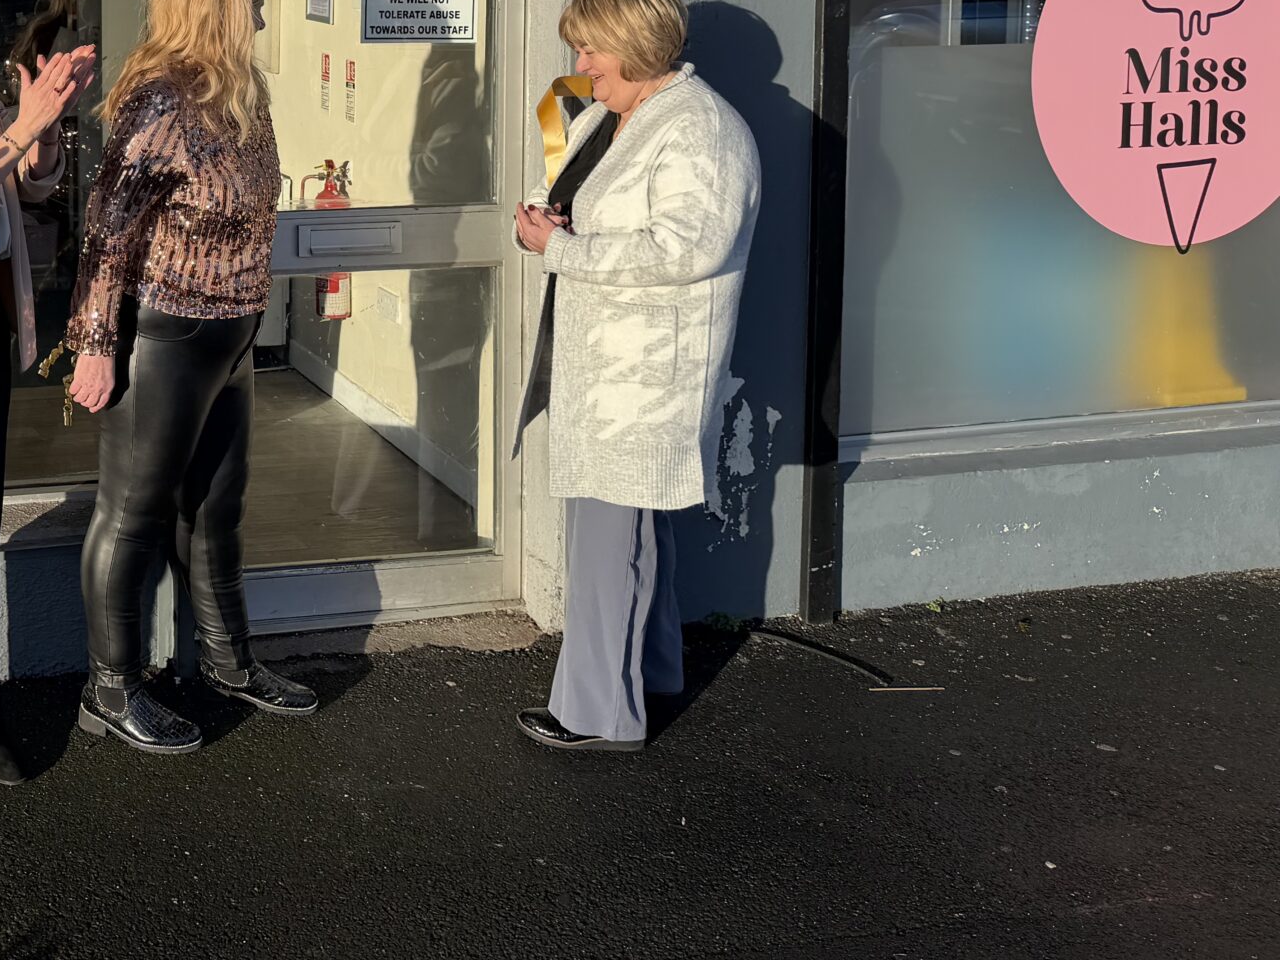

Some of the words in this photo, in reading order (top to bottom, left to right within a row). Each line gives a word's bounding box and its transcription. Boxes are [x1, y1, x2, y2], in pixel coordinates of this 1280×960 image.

[378, 10, 427, 20] TOLERATE
[429, 10, 461, 20] ABUSE
[369, 25, 415, 35] TOWARDS
[417, 25, 438, 35] OUR
[440, 25, 469, 35] STAFF
[1122, 46, 1247, 95] Miss
[1117, 98, 1246, 149] Halls
